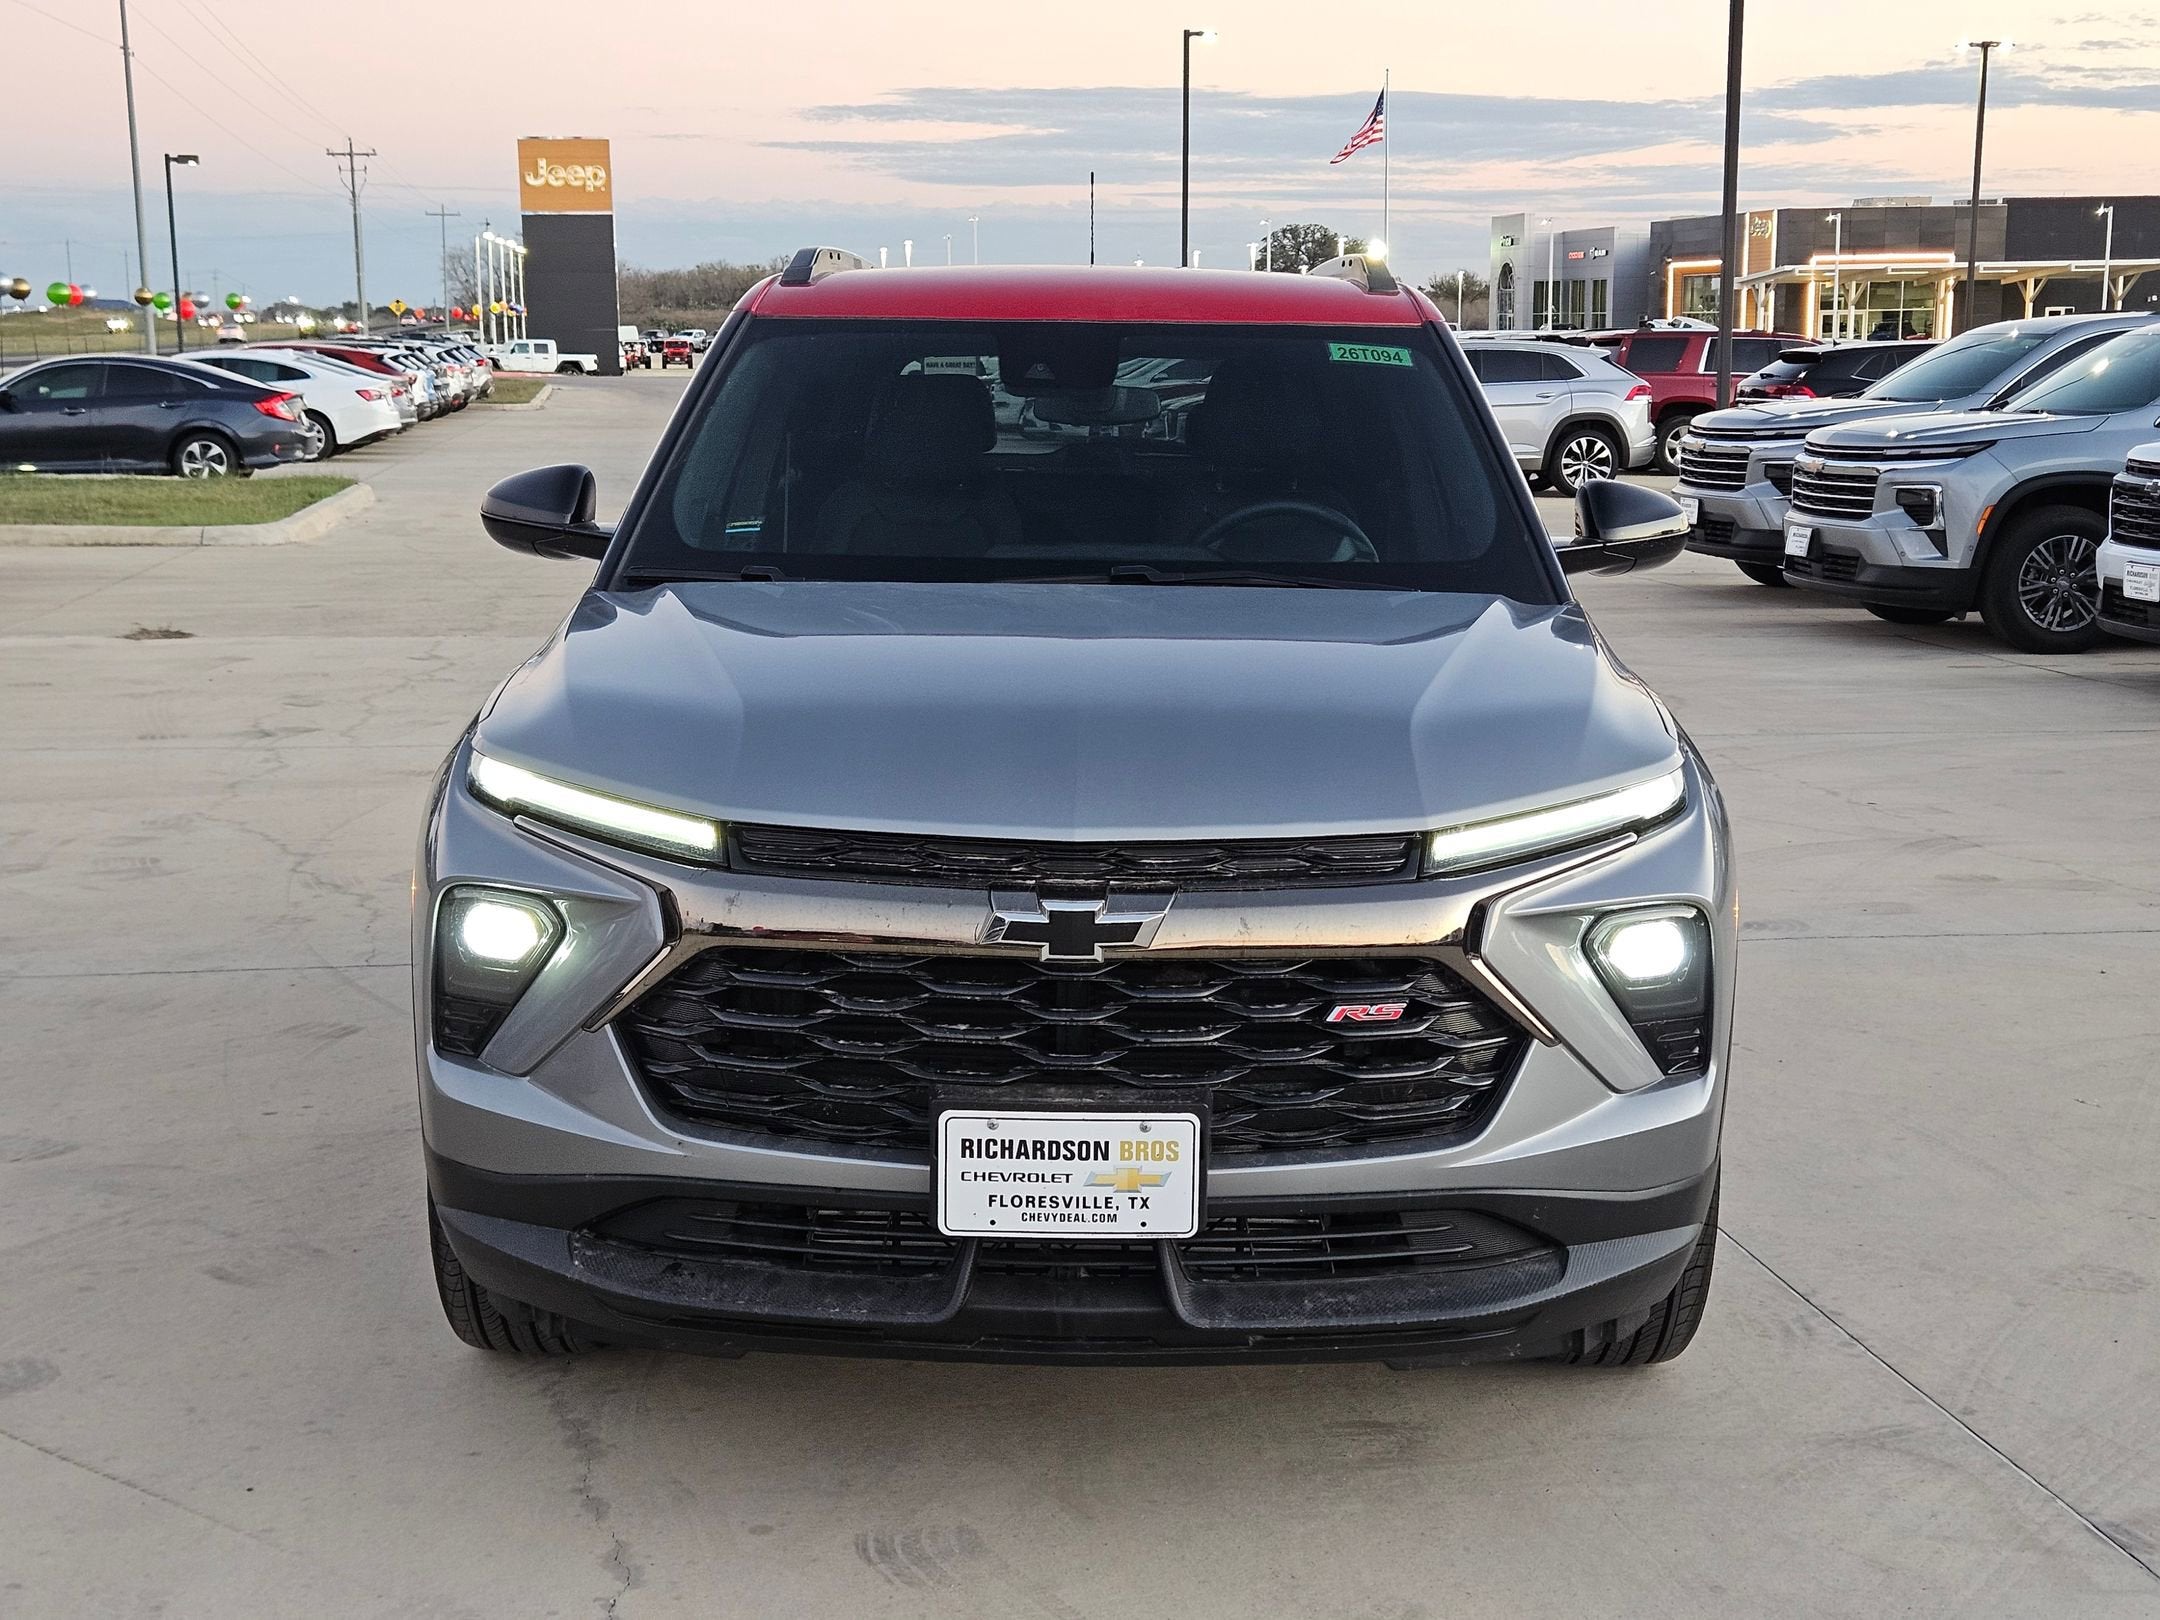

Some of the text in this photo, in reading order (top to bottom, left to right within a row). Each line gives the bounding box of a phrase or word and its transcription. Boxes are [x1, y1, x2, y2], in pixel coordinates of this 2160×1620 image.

[524, 157, 606, 192] Jeep
[1337, 347, 1404, 363] 26T094
[1326, 1003, 1408, 1022] RS
[960, 1138, 1180, 1162] RICHARDSON BROS
[960, 1171, 1073, 1184] CHEVROLET
[988, 1195, 1151, 1211] FLORESVILLE, TX
[1021, 1212, 1118, 1224] CHEVYDEAL.COM
